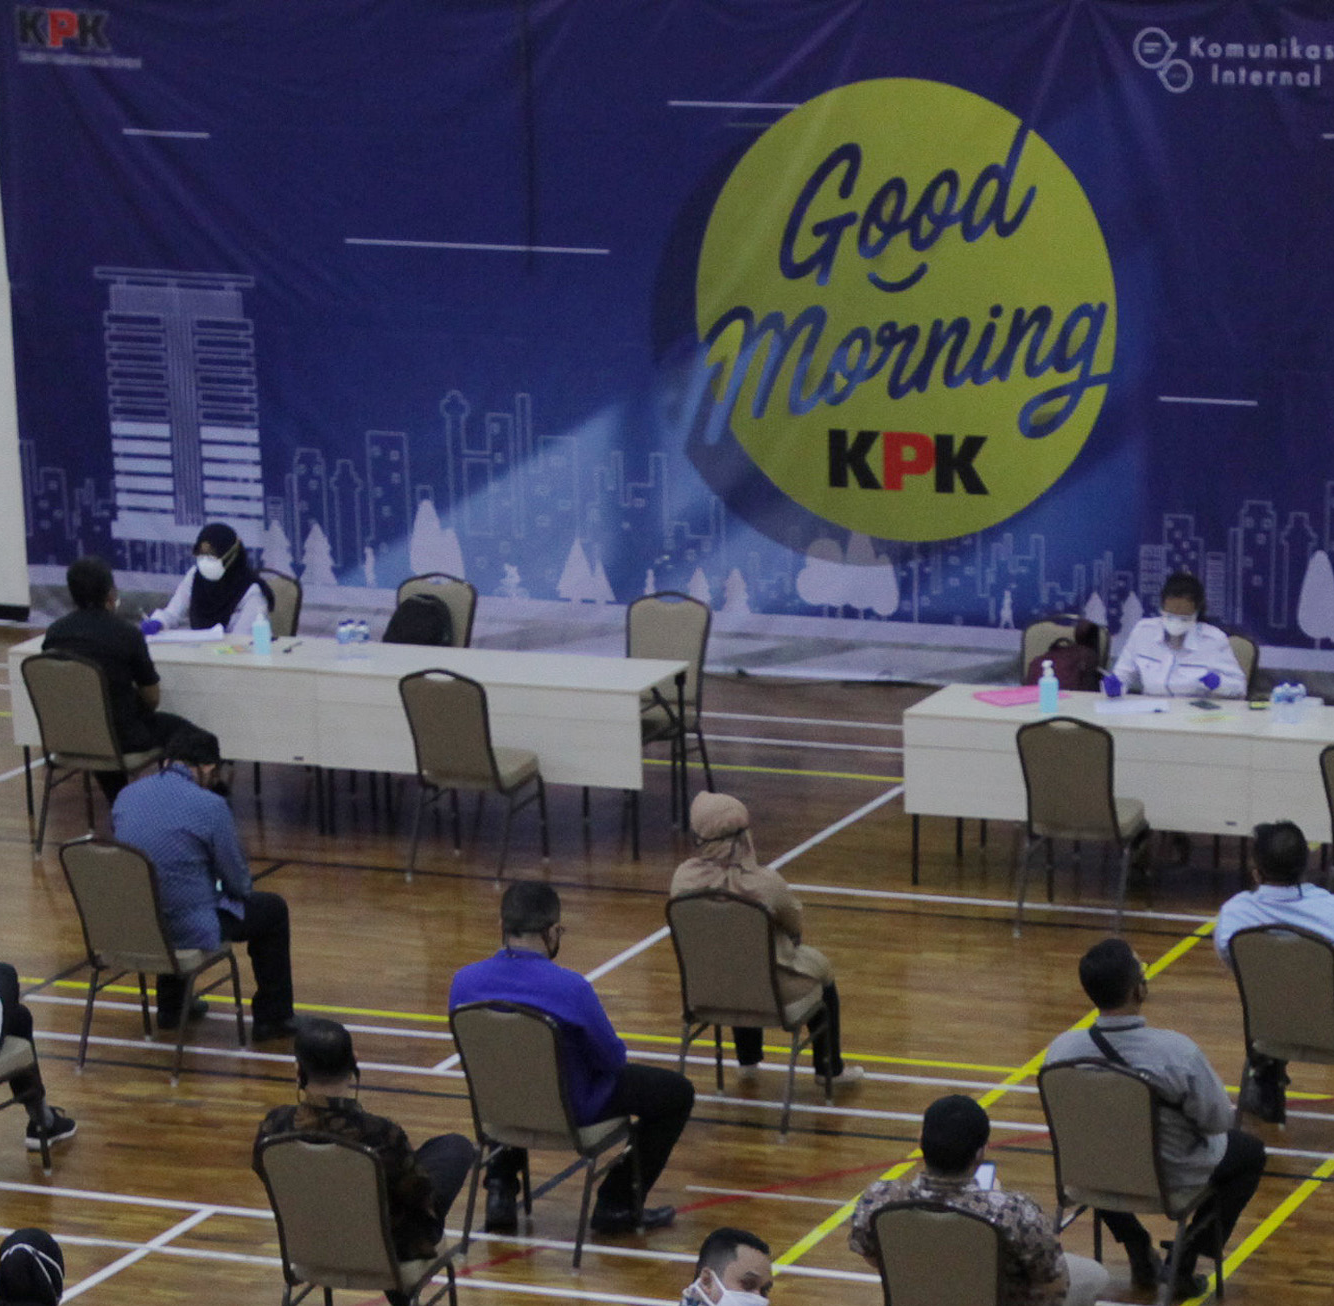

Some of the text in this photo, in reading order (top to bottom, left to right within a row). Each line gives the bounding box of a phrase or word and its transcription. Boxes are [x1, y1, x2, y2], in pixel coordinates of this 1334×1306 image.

[18, 8, 111, 51] KPK
[1211, 64, 1321, 87] Internal
[779, 120, 1037, 286] Good
[689, 301, 1113, 445] Morning
[828, 428, 989, 495] KPK
